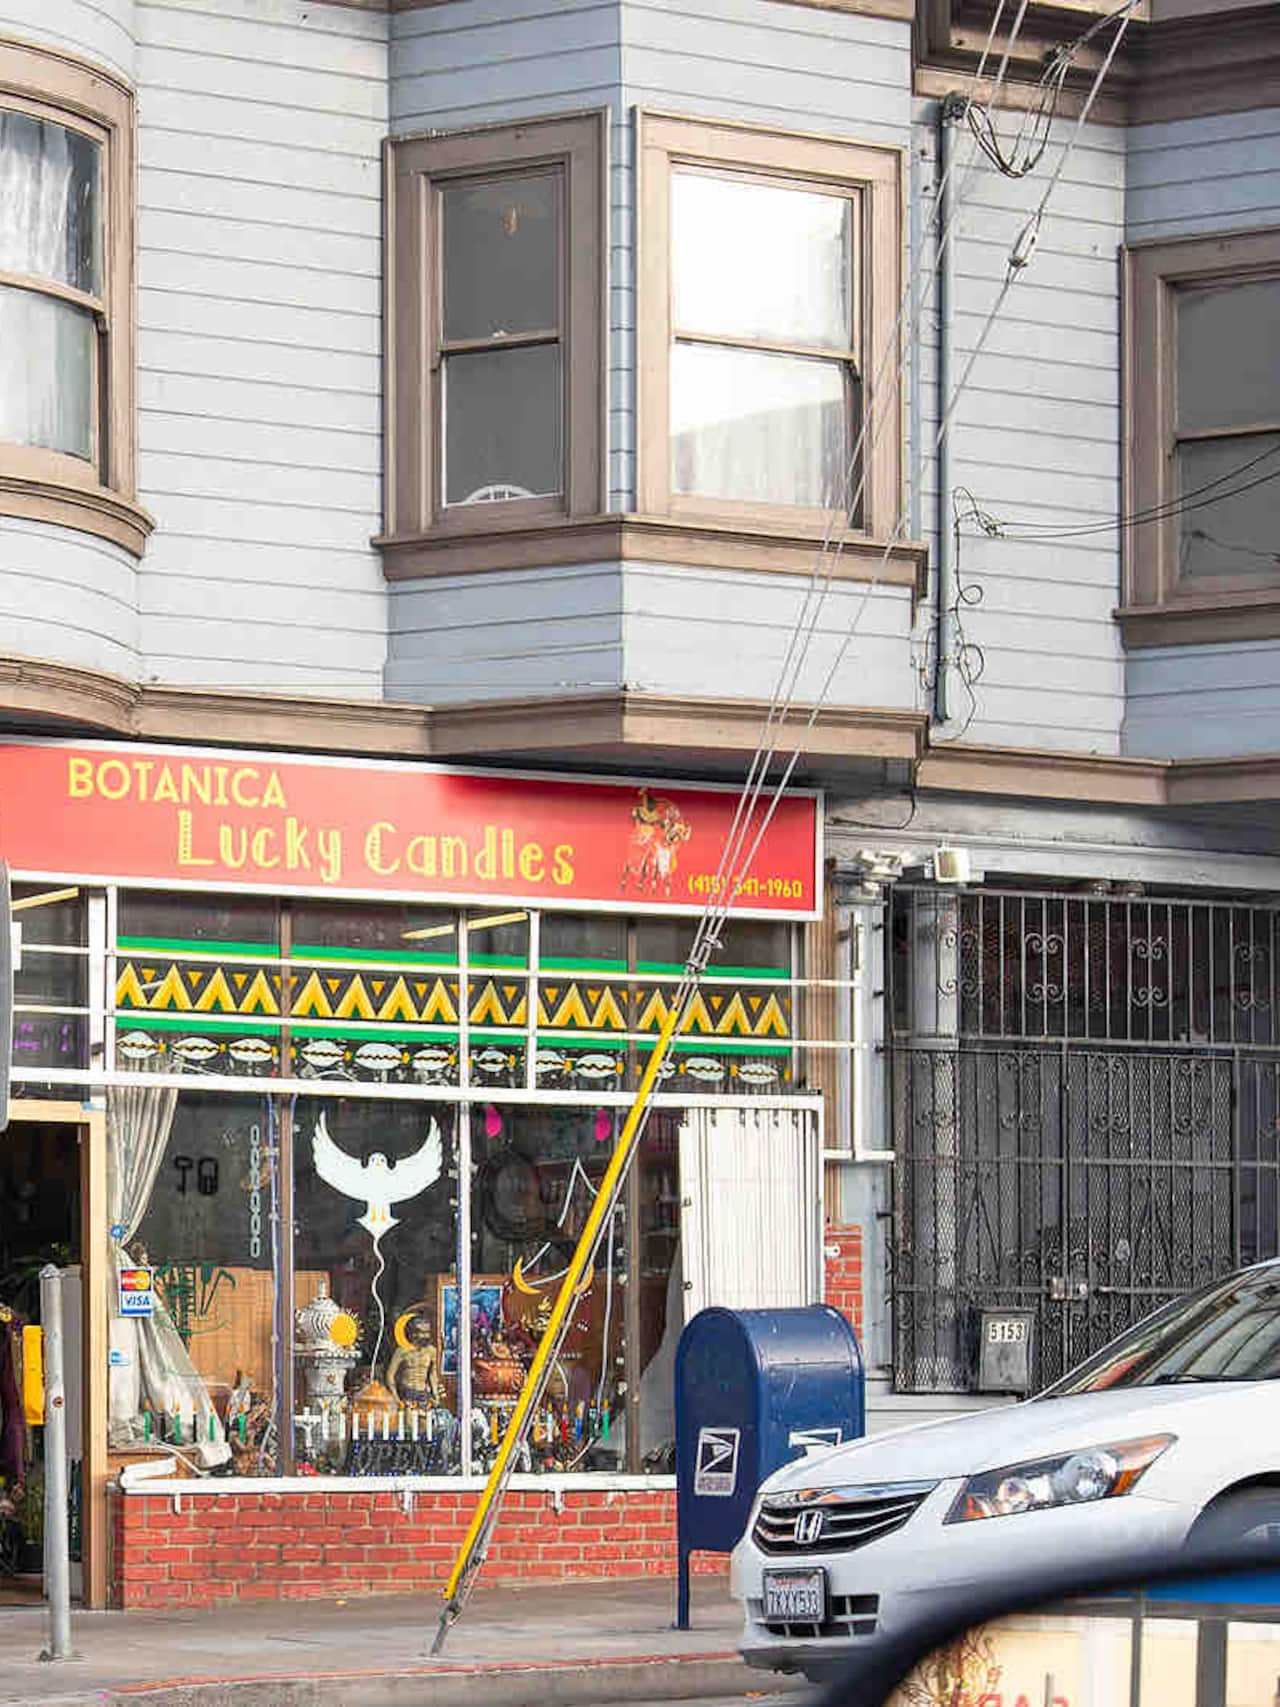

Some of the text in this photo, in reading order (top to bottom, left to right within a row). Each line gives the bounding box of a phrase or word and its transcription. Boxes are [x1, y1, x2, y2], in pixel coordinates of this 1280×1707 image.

[67, 756, 288, 810] BOTANICA
[177, 808, 575, 886] Lucky Candles
[126, 1295, 150, 1306] VISA
[990, 1323, 1024, 1341] 5153
